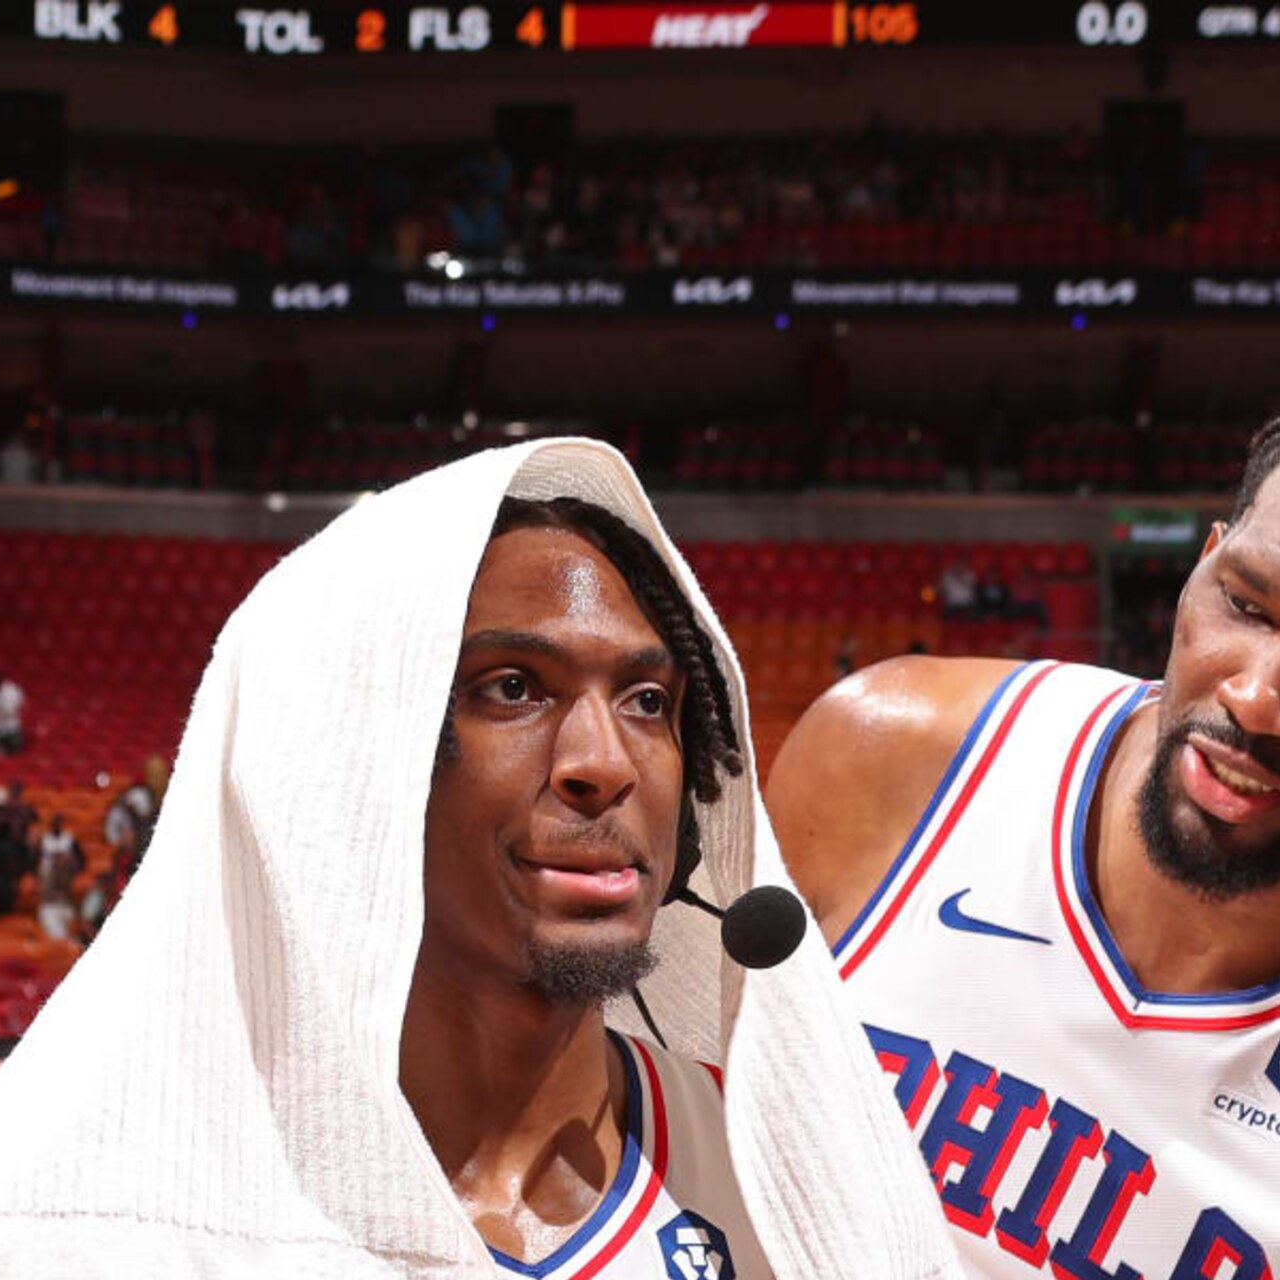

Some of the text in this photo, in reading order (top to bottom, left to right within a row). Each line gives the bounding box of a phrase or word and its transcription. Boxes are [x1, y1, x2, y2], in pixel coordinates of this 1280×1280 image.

[33, 0, 121, 42] BLK
[148, 5, 179, 44] 4
[236, 8, 323, 55] TOL
[355, 9, 386, 52] 2
[408, 6, 491, 52] FLS
[516, 8, 546, 47] 4
[651, 4, 768, 47] HEAT
[1075, 0, 1148, 46] 0.0
